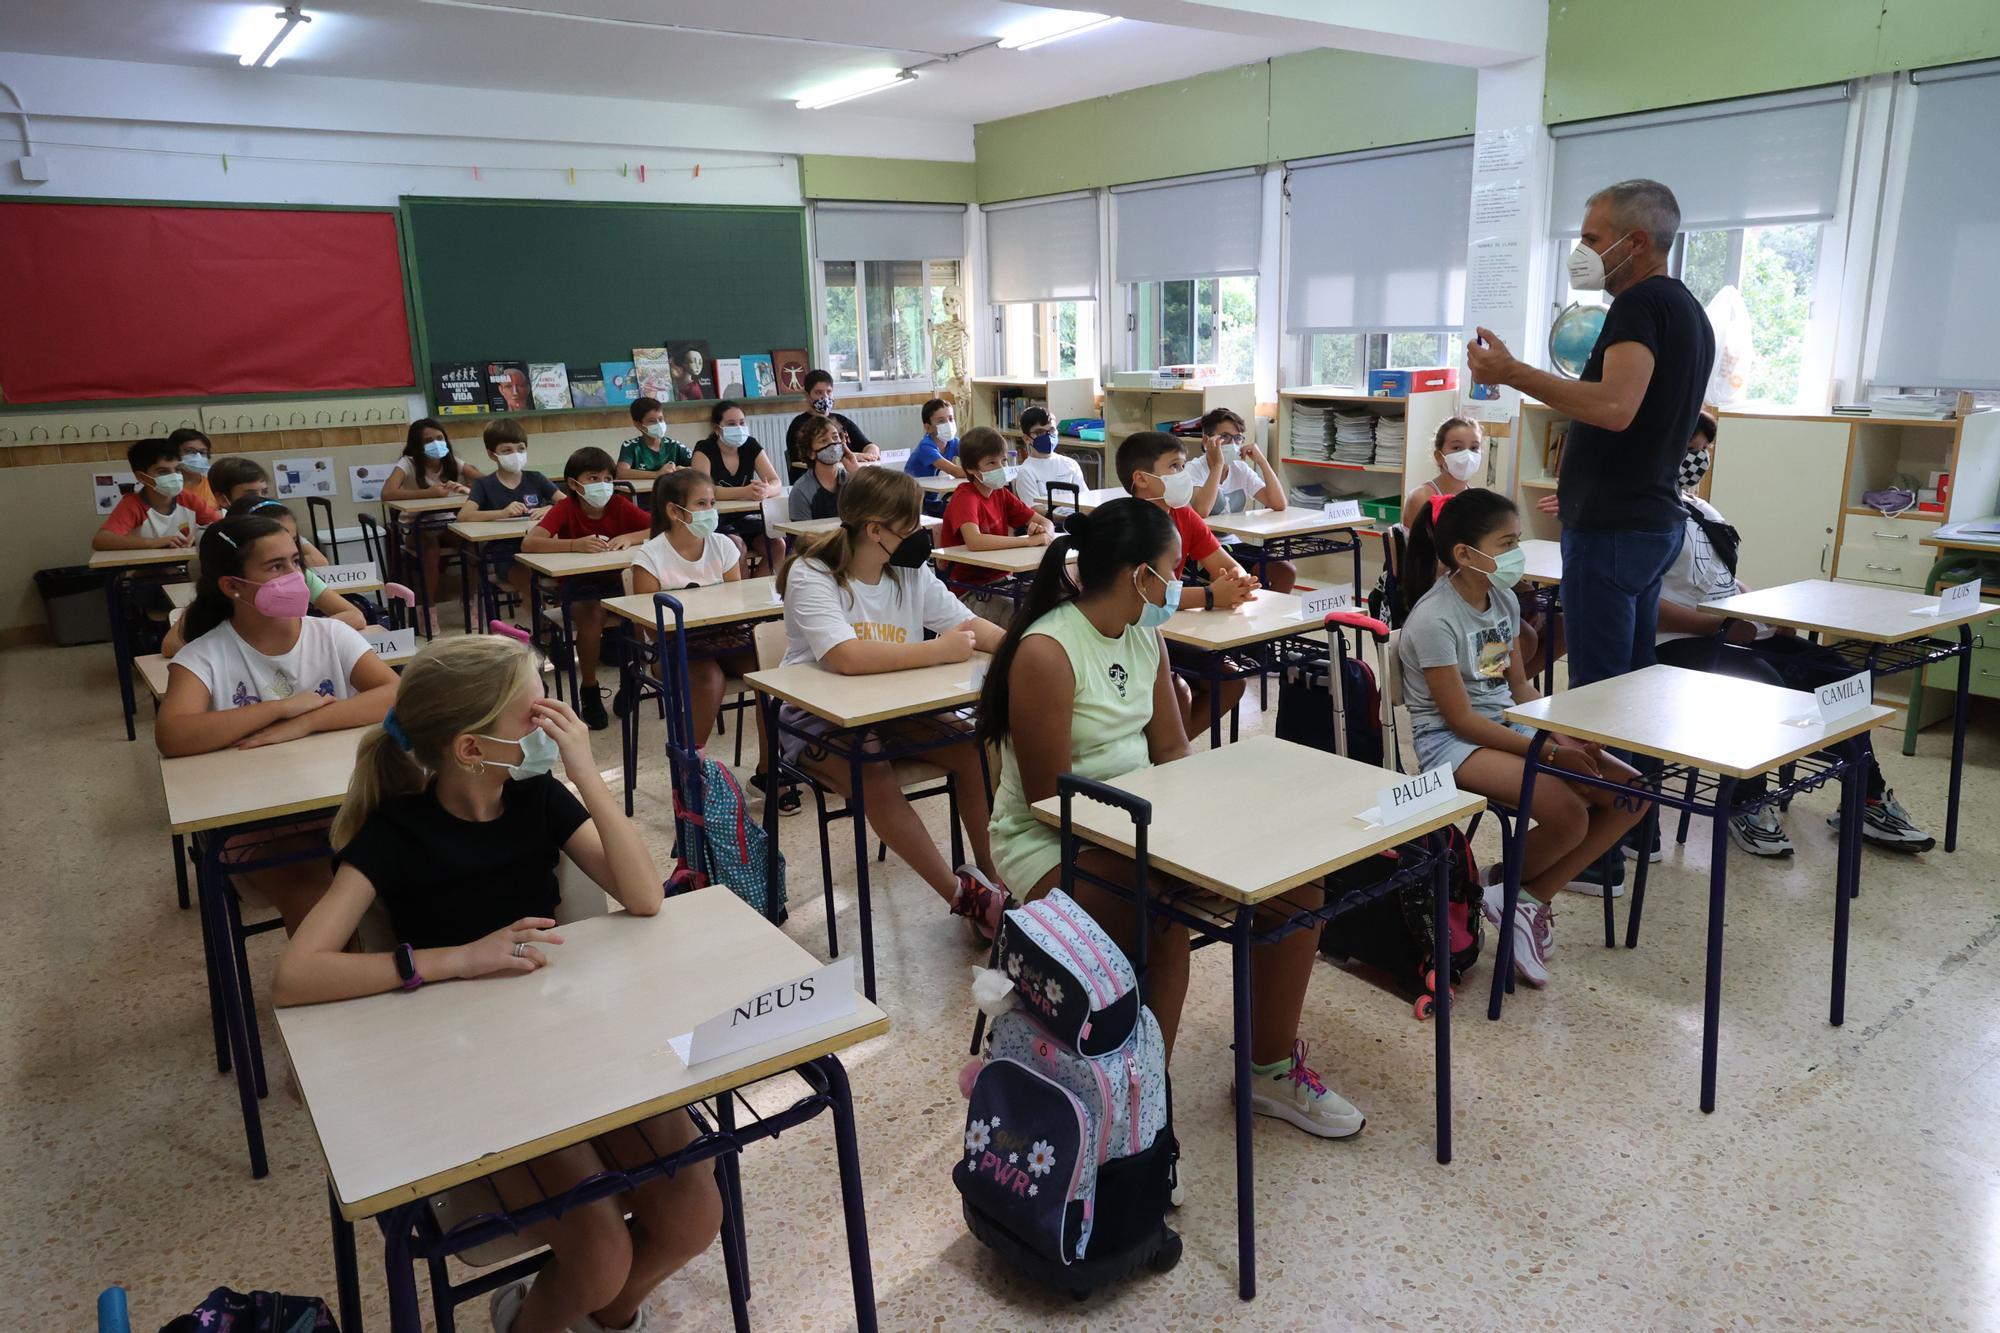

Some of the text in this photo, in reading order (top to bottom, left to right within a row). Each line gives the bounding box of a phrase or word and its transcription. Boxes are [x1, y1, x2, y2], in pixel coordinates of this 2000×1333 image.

[441, 381, 480, 389] L'AVENTURA
[452, 392, 473, 401] VIDA
[319, 571, 367, 584] NACHO
[1952, 584, 1970, 600] LUIS
[1308, 594, 1347, 614] STEFAN
[371, 641, 397, 654] CIA
[1821, 679, 1865, 706] CAMILA
[1392, 771, 1442, 806] PAULA
[730, 977, 815, 1028] NEUS
[979, 1150, 1030, 1198] PWR
